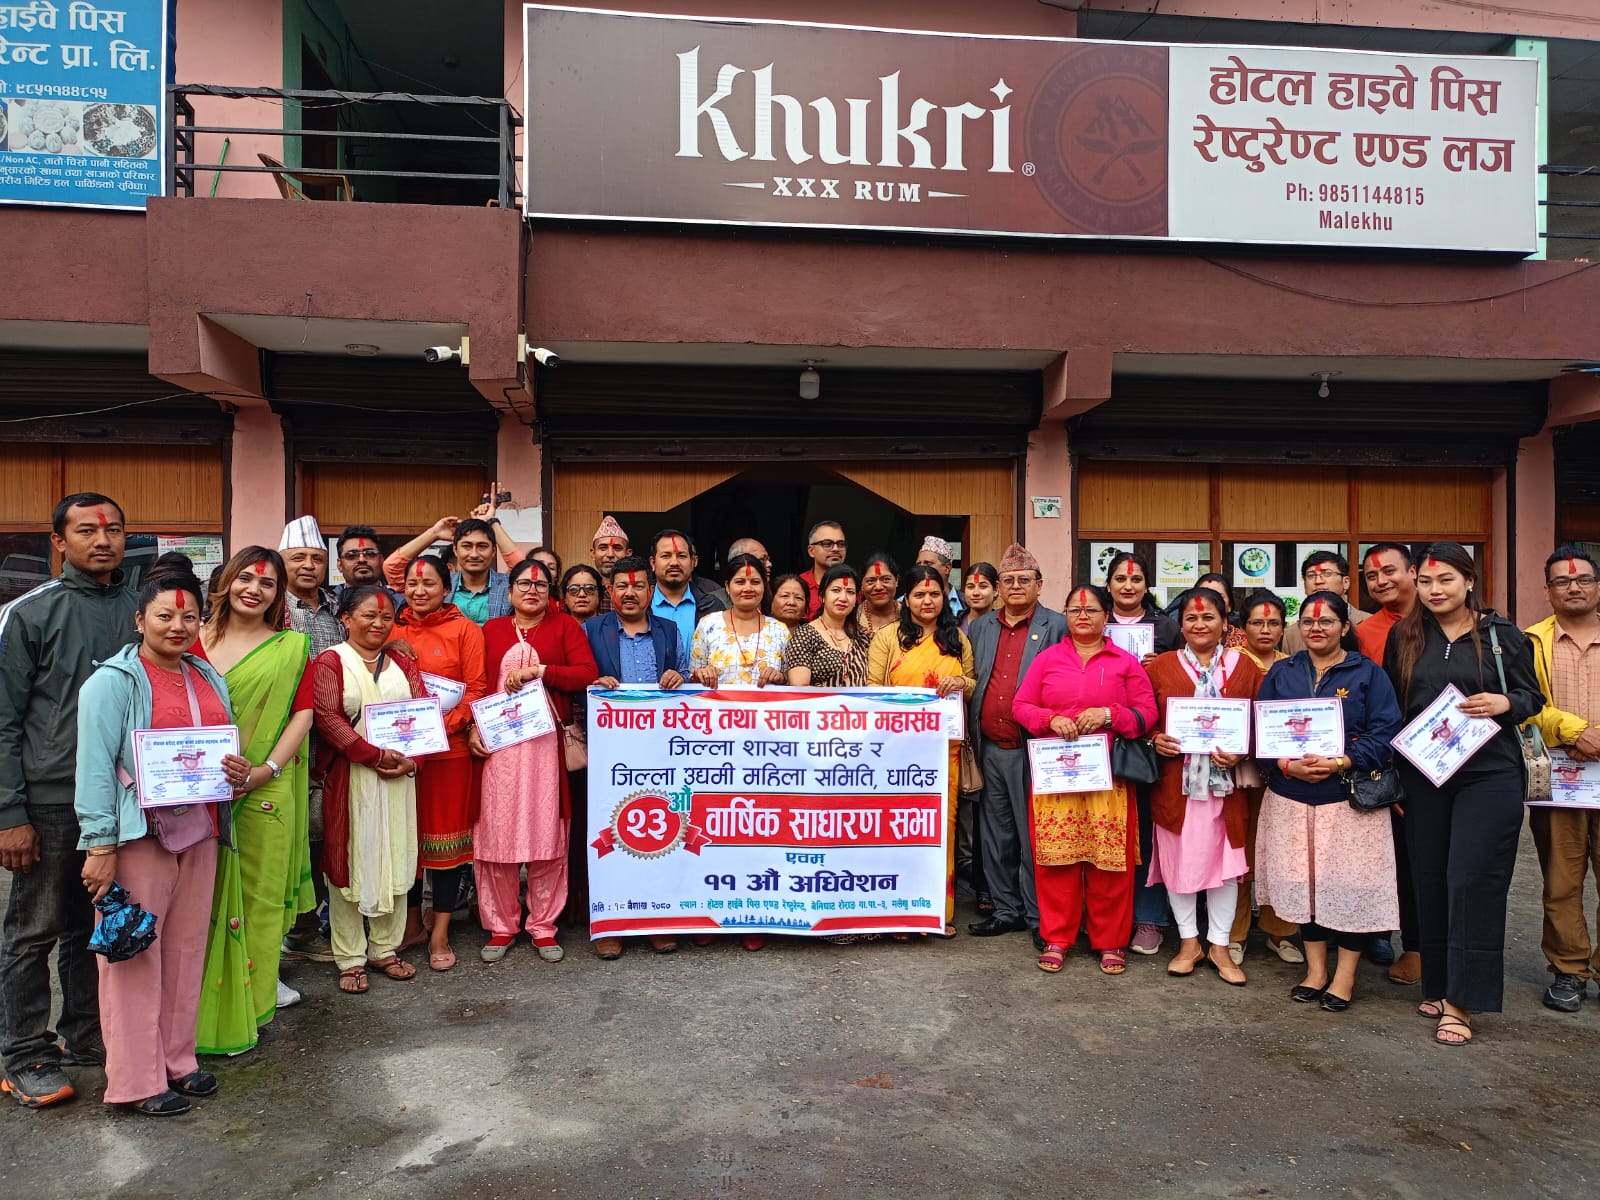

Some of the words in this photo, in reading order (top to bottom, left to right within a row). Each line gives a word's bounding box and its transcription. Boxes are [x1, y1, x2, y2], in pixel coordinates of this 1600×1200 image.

[69, 1, 127, 34] पिस
[60, 45, 99, 70] प्रा.
[109, 40, 156, 71] लि.
[1209, 56, 1316, 106] होटल
[1327, 64, 1418, 115] हाइवे
[1430, 65, 1501, 116] पिस
[675, 45, 1014, 173] Khukri
[1193, 114, 1341, 173] रेष्टुरेण्ट
[1353, 133, 1431, 168] एण्ड
[1443, 137, 1515, 172] लज
[772, 177, 841, 199] XXX
[855, 180, 921, 202] RUM
[1286, 183, 1313, 202] Ph:
[1319, 183, 1424, 205] 9851144815
[1319, 210, 1393, 231] Malekhu
[596, 702, 656, 730] नेपाल
[662, 702, 712, 735] घरेलु
[718, 709, 758, 730] तथा
[764, 710, 810, 731] साना
[816, 704, 868, 731] उद्योग
[874, 707, 941, 733] महासंघ
[668, 736, 735, 756] जिल्ला
[742, 741, 799, 757] शाखा
[807, 737, 863, 759] धादिङ
[870, 742, 884, 757] र
[611, 763, 676, 786] जिल्ला
[742, 763, 807, 786] महिला
[814, 763, 877, 790] समिति,
[887, 764, 938, 788] धादिङ
[626, 808, 668, 841] २३
[705, 797, 781, 837] वार्षिक
[789, 808, 882, 840] साधारण
[889, 807, 937, 840] सभा
[785, 852, 826, 866] एवम्
[704, 874, 736, 891] ११
[789, 869, 899, 893] अधिवेशन
